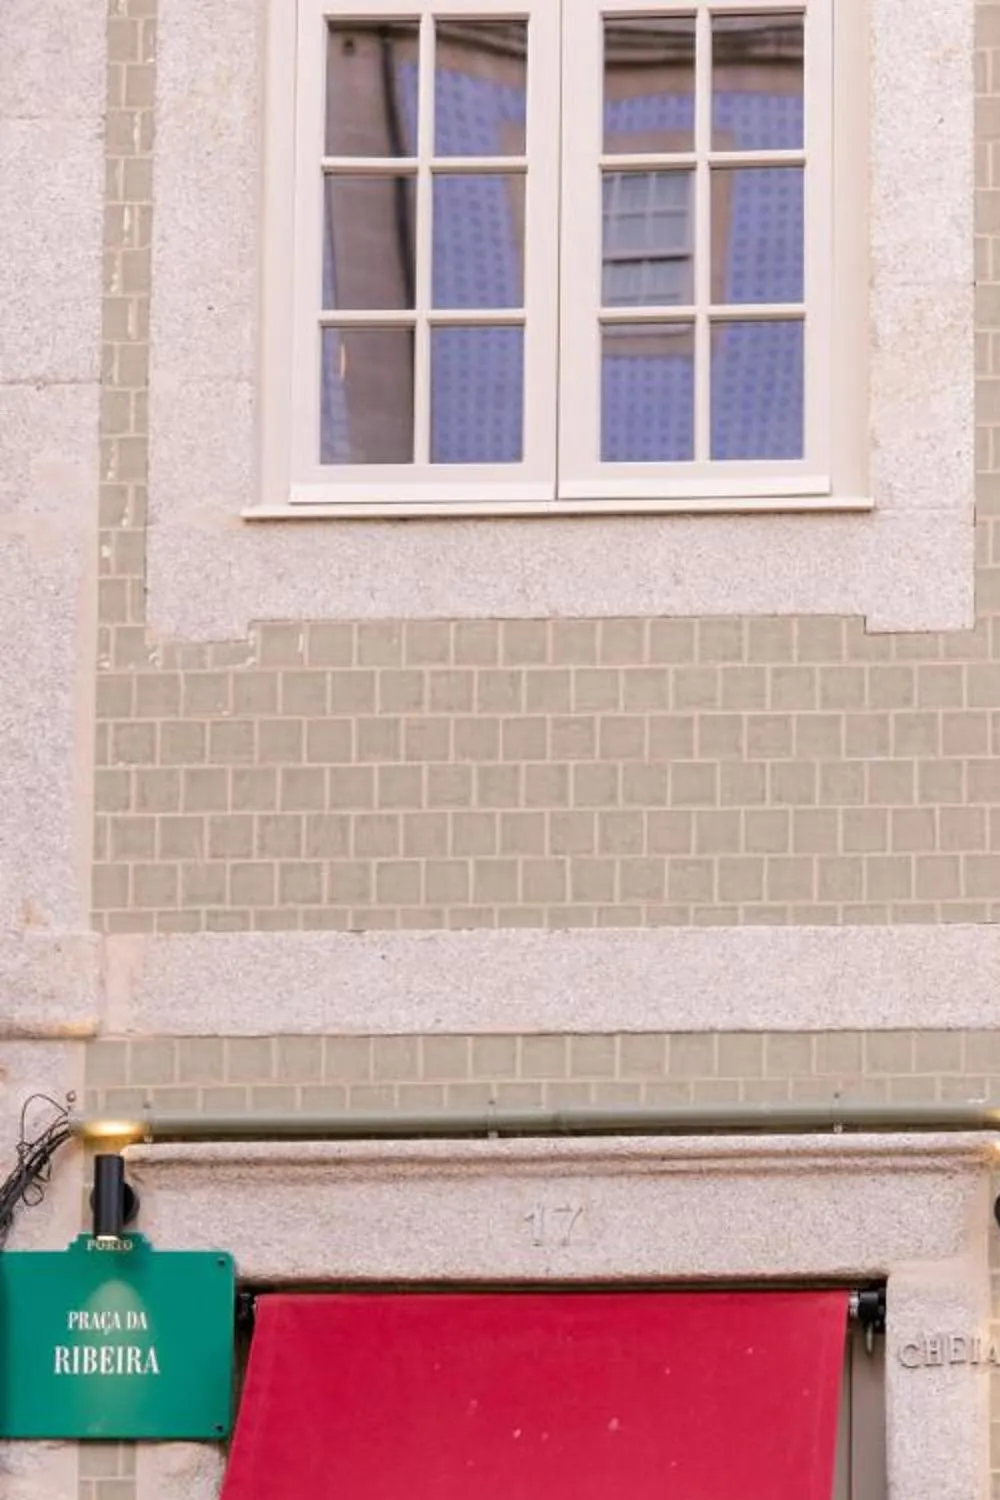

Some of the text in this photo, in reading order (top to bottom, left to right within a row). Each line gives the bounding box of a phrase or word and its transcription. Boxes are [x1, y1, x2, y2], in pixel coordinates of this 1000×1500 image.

[523, 1201, 586, 1247] 17
[67, 1310, 148, 1335] PRAÇA DA
[54, 1345, 160, 1375] RIBEIRA
